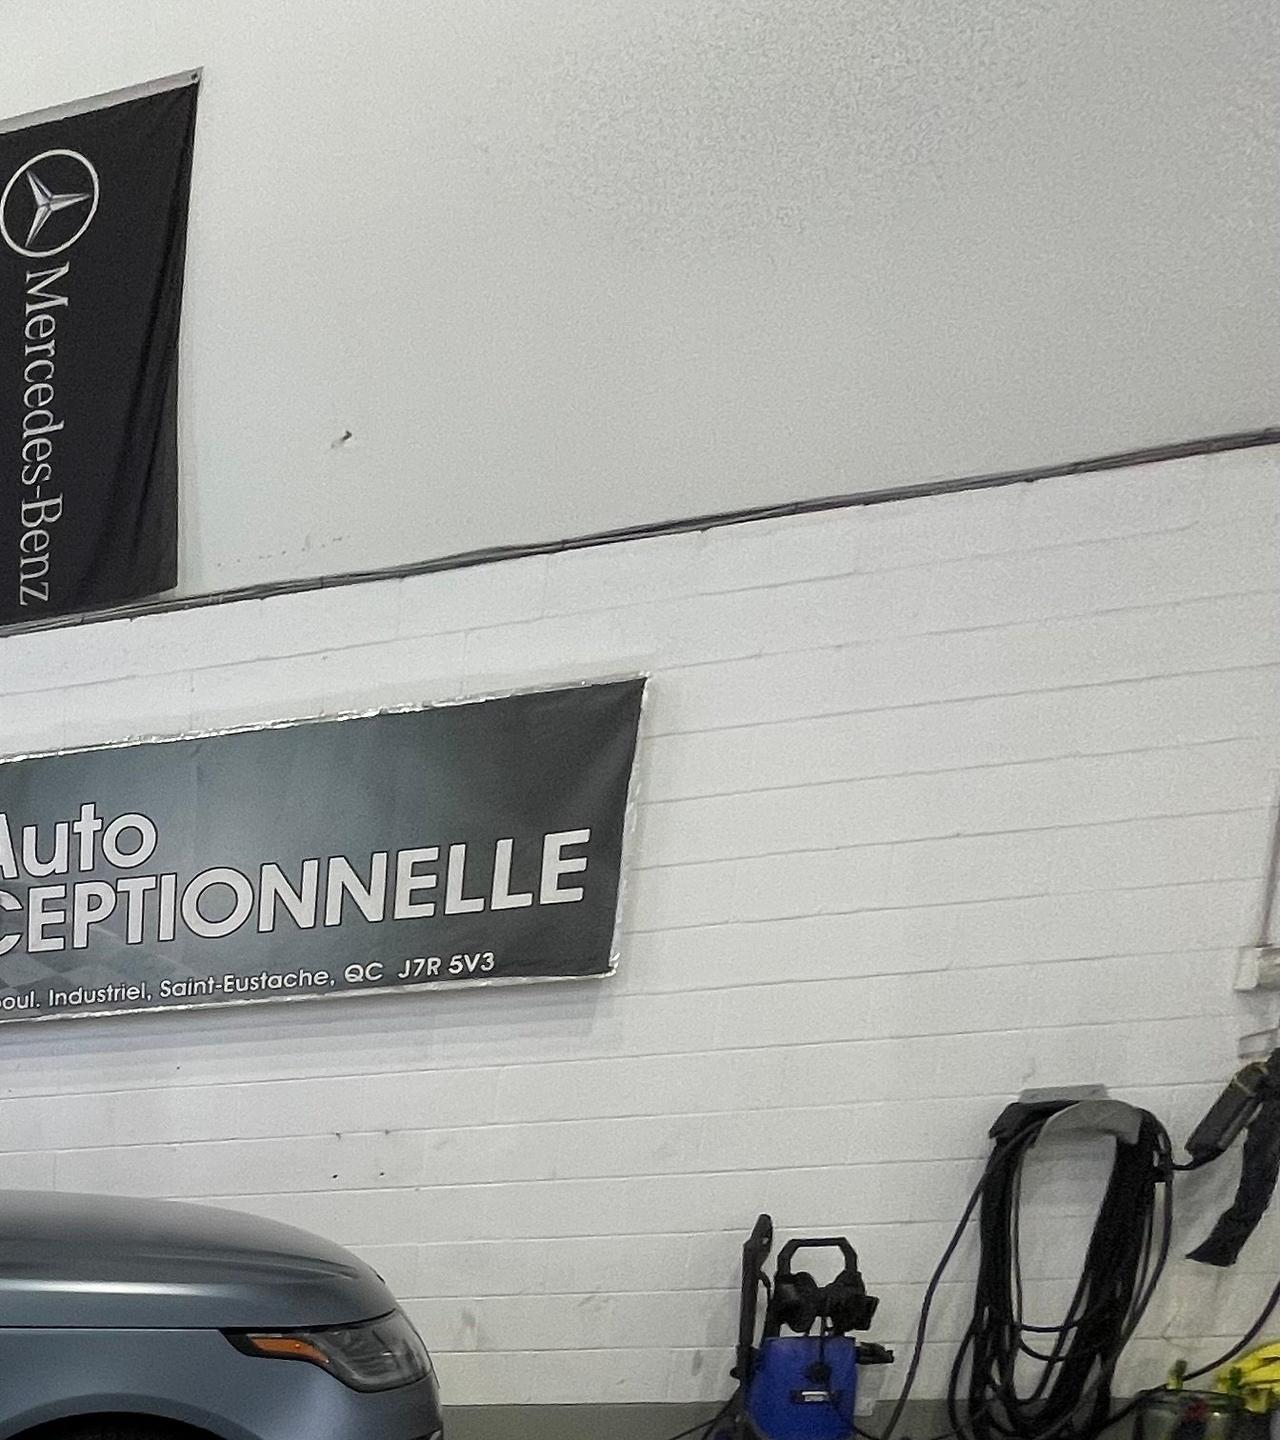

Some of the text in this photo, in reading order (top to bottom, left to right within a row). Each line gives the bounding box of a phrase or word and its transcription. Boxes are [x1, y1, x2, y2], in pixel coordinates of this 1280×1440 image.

[17, 262, 71, 607] Mercedes-Benz
[48, 982, 153, 1006] Industriel,
[159, 968, 336, 998] Saint-Eustache,
[343, 961, 384, 982] QC
[397, 957, 442, 979] J7R
[448, 951, 496, 975] 5V3
